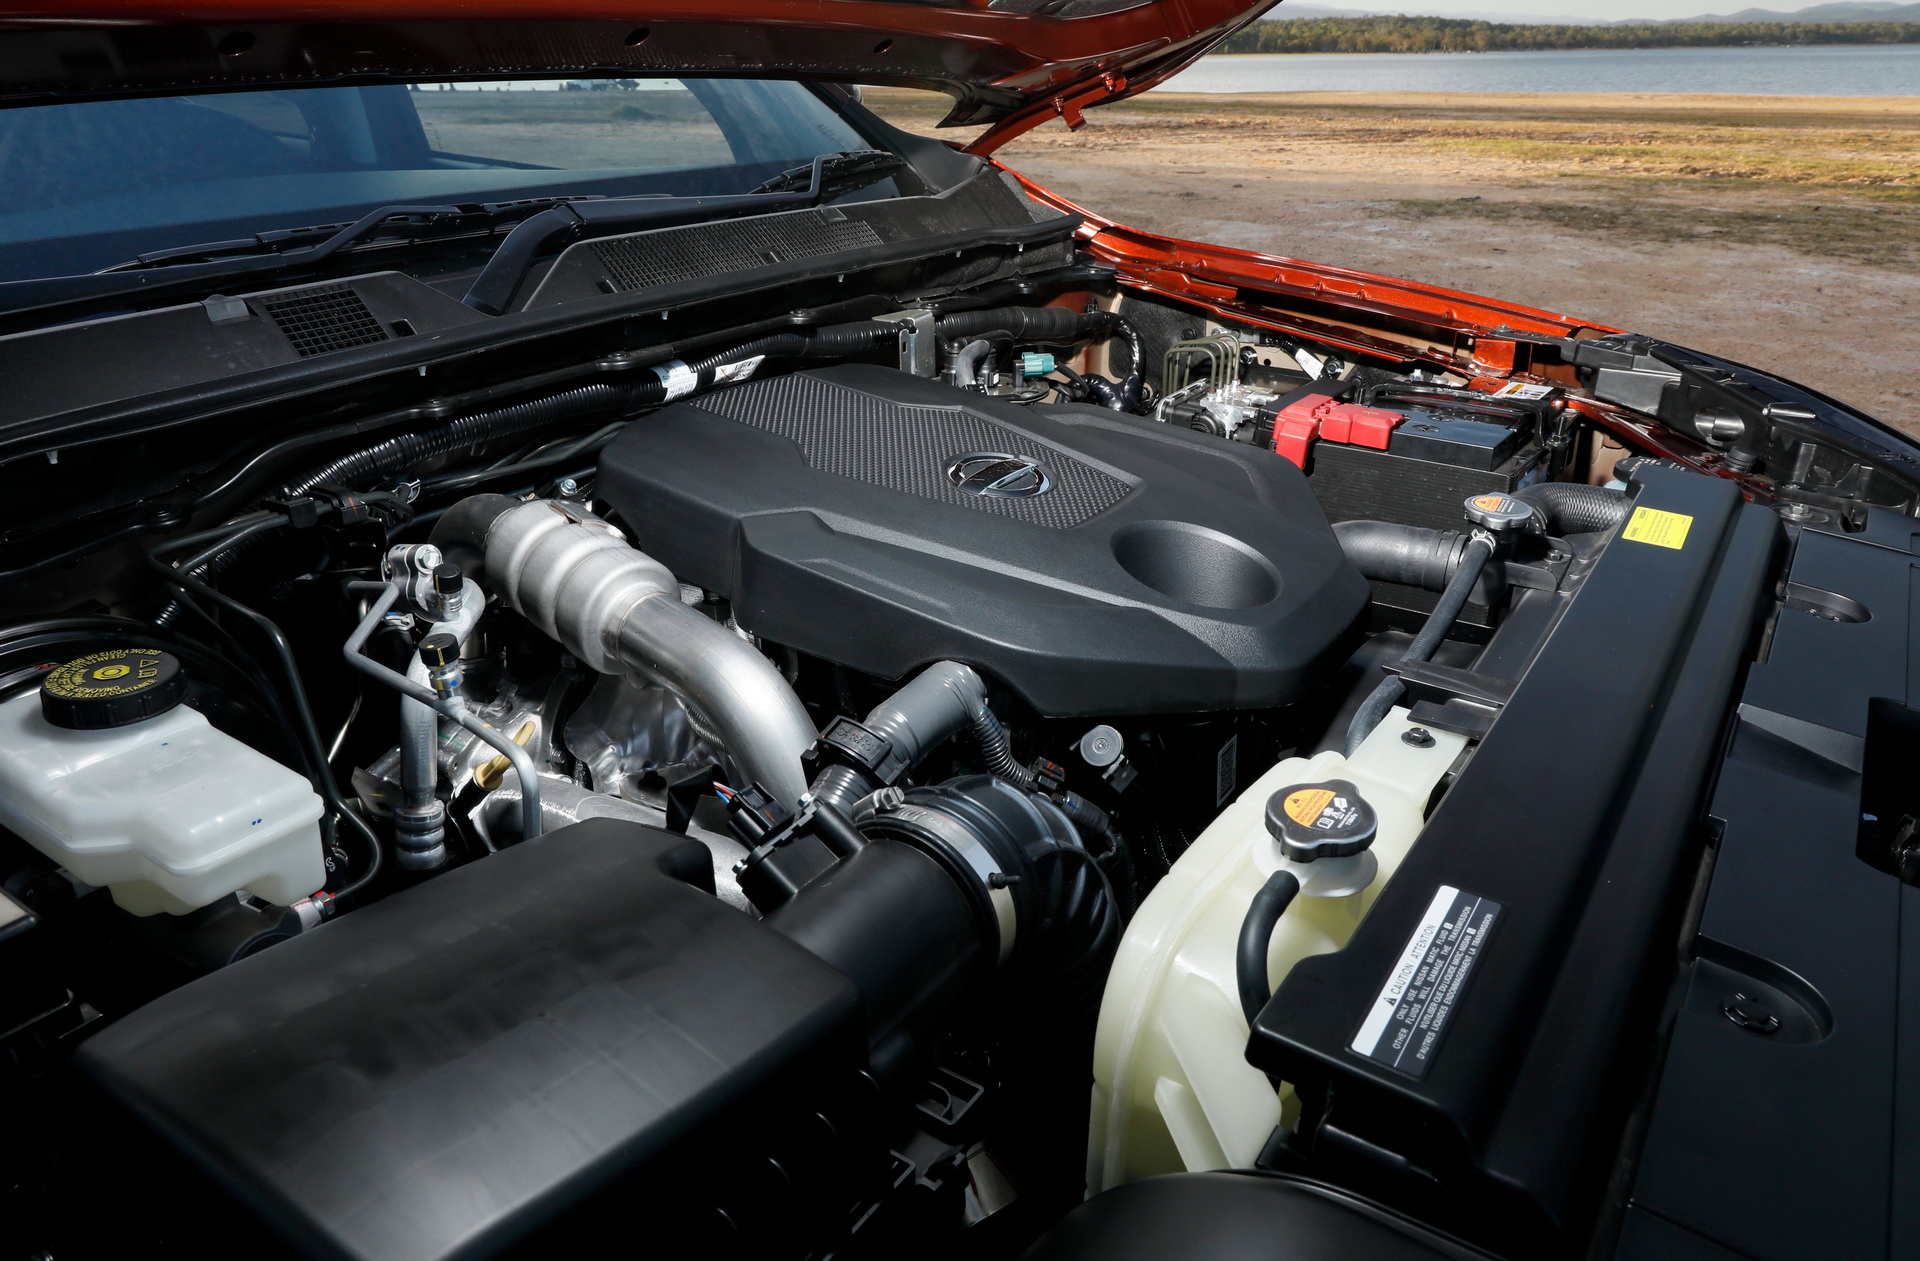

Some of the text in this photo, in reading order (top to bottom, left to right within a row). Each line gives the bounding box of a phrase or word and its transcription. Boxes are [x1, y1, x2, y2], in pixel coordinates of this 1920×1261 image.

[1471, 912, 1494, 946] TRANSMISSION
[1391, 963, 1414, 995] CAUTION
[1411, 924, 1437, 959] ATTENTION
[1452, 951, 1464, 967] MATIC
[1458, 934, 1473, 953] NISSAN
[1467, 947, 1477, 955] LA
[1392, 905, 1472, 1050] OTHER FLUIDS WILL DAMAGE THE TRANSMISSION
[1396, 1003, 1410, 1020] ONLY
[1406, 988, 1418, 1002] USE
[1414, 965, 1430, 987] NISSAN
[1426, 946, 1440, 964] MATIC
[1436, 929, 1449, 945] FLUID
[1430, 1005, 1449, 1031] LIQUIDES
[1416, 1031, 1436, 1060] D'AUTRES
